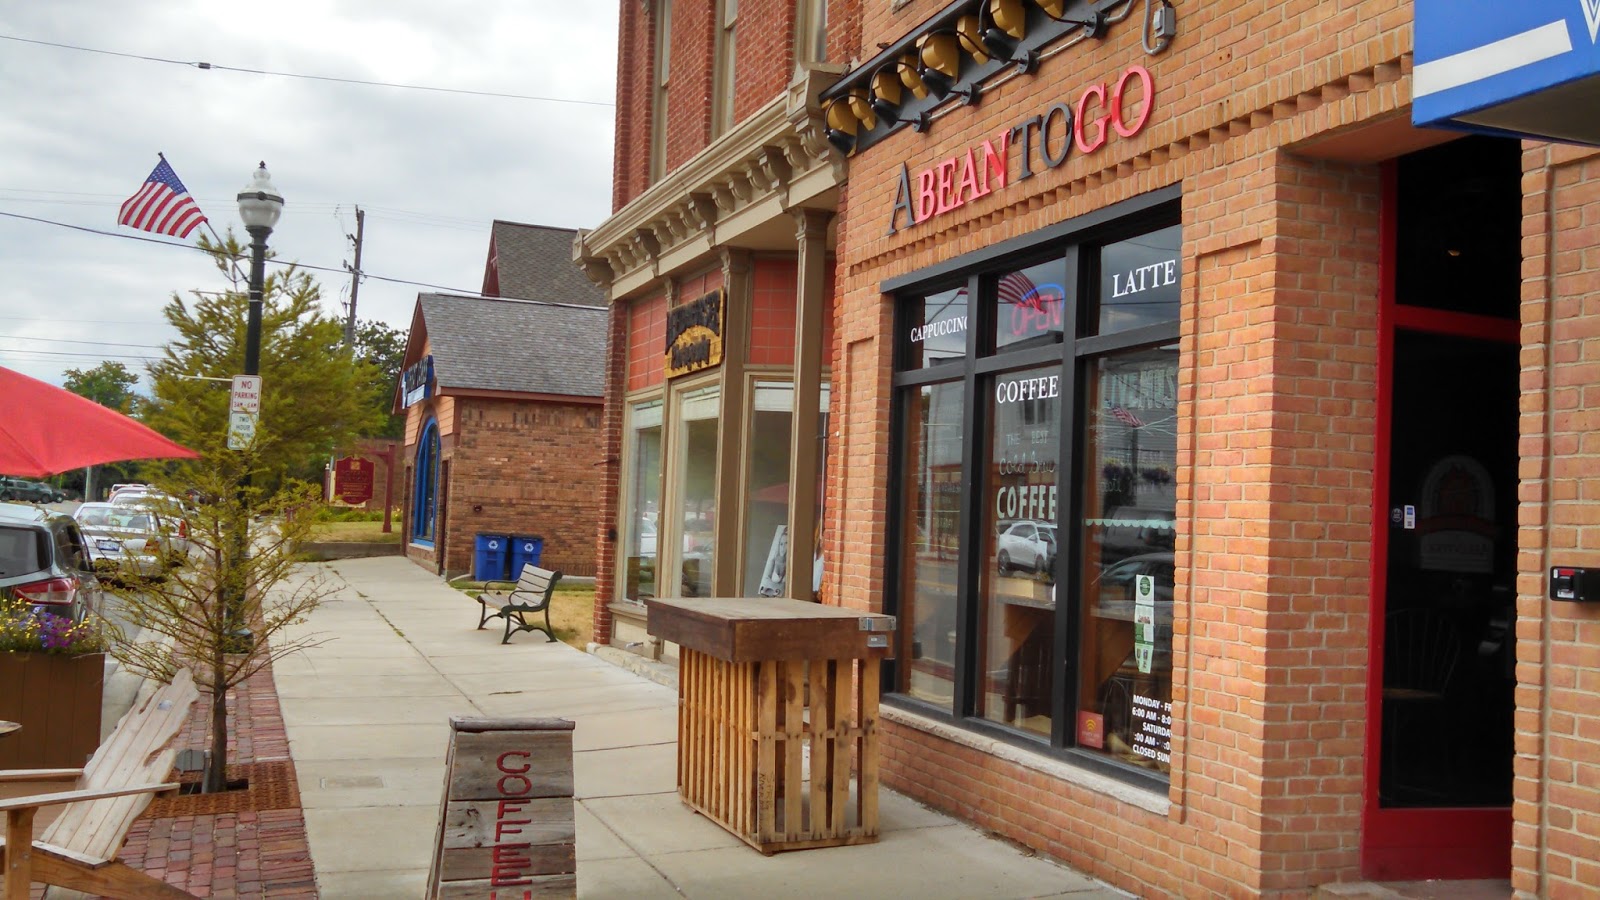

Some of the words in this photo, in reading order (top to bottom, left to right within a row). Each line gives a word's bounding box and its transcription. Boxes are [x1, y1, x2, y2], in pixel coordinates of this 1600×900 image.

[886, 161, 917, 235] A
[914, 128, 1010, 225] BEAN
[1010, 102, 1073, 181] TO
[1074, 64, 1155, 154] GO
[1112, 259, 1177, 298] LATTE
[1012, 292, 1063, 336] OPEN
[241, 380, 253, 389] NO
[996, 375, 1059, 404] COFFEE
[234, 391, 258, 400] PARKING
[1006, 433, 1020, 446] THE
[1031, 430, 1049, 444] BEST
[996, 484, 1057, 520] COFFEE
[1133, 694, 1160, 709] MONDAY
[1132, 706, 1145, 718] 6:00
[1145, 710, 1157, 721] AM
[1144, 735, 1156, 746] AM
[1132, 743, 1156, 759] CLOSED
[490, 750, 533, 887] COFFEE
